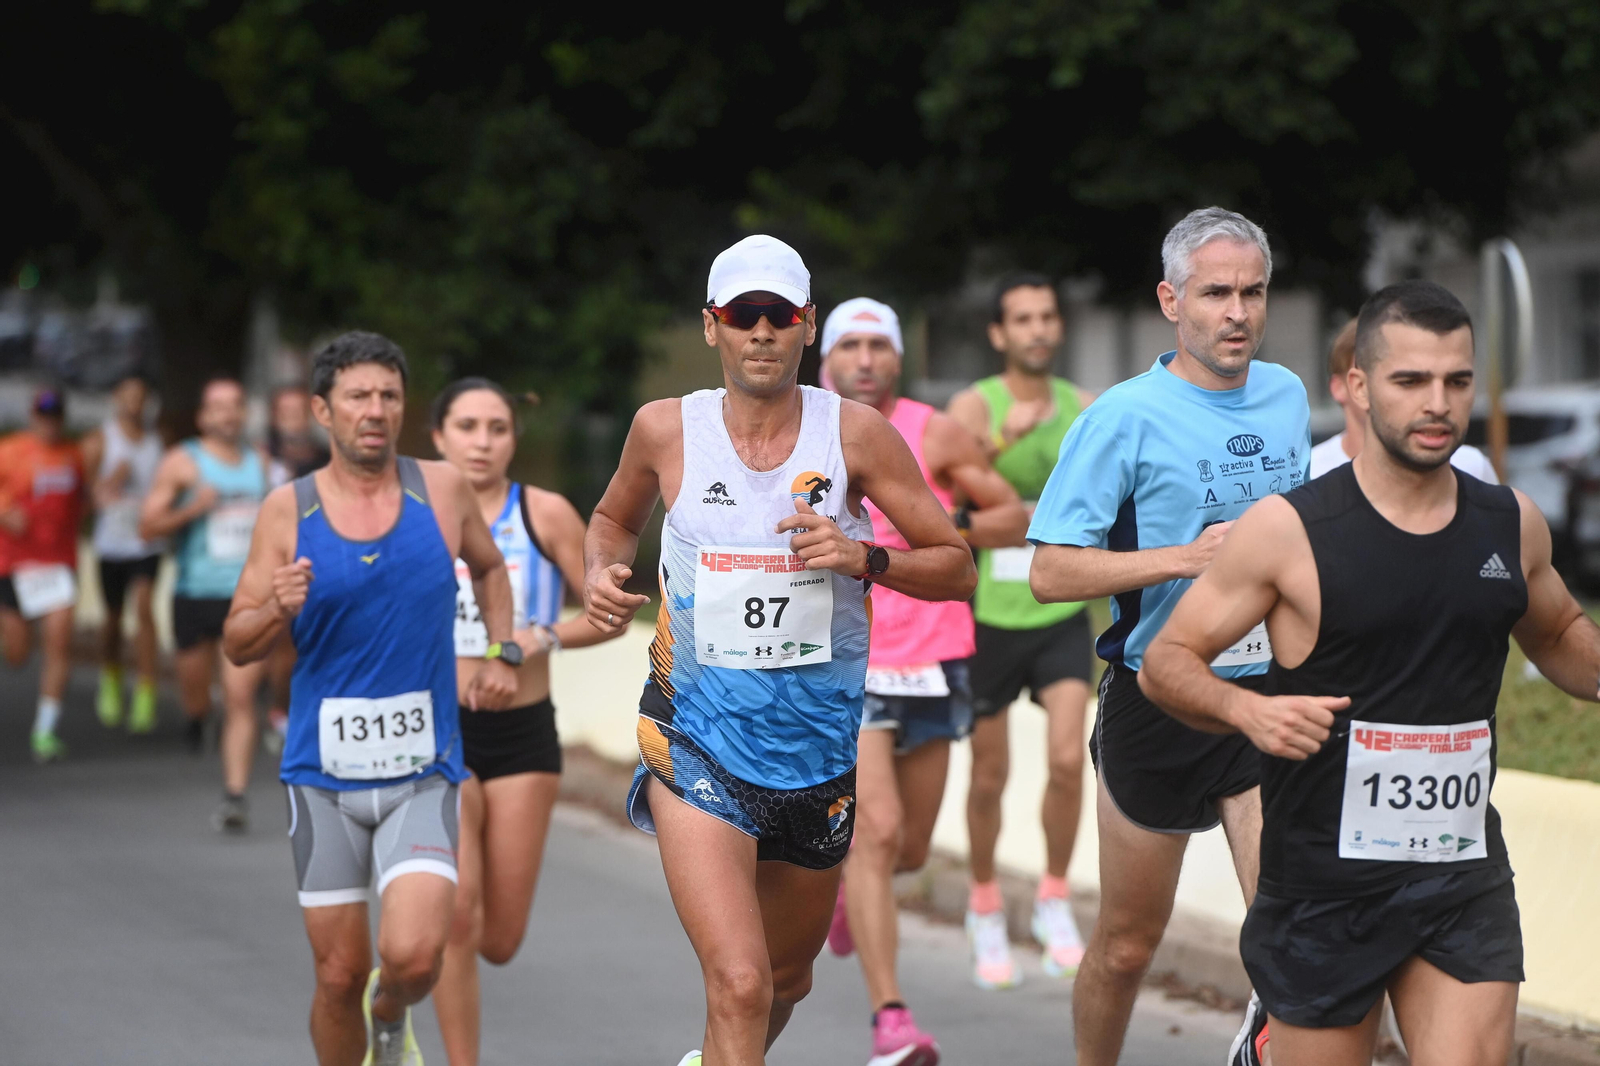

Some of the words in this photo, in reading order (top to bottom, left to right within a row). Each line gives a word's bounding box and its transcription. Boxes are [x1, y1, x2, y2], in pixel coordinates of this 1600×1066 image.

[1227, 436, 1264, 453] TROPS
[1230, 459, 1254, 470] activa
[701, 552, 733, 572] 42
[733, 554, 785, 564] CARRERA
[790, 577, 825, 588] FEDERADO
[1480, 569, 1511, 580] adidas
[743, 597, 790, 629] 87
[332, 708, 425, 742] 13133
[1355, 729, 1392, 752] 42
[1394, 732, 1451, 743] CARRERA
[1453, 728, 1489, 742] URBANA
[1429, 742, 1472, 753] MALAGA
[1363, 772, 1481, 811] 13300
